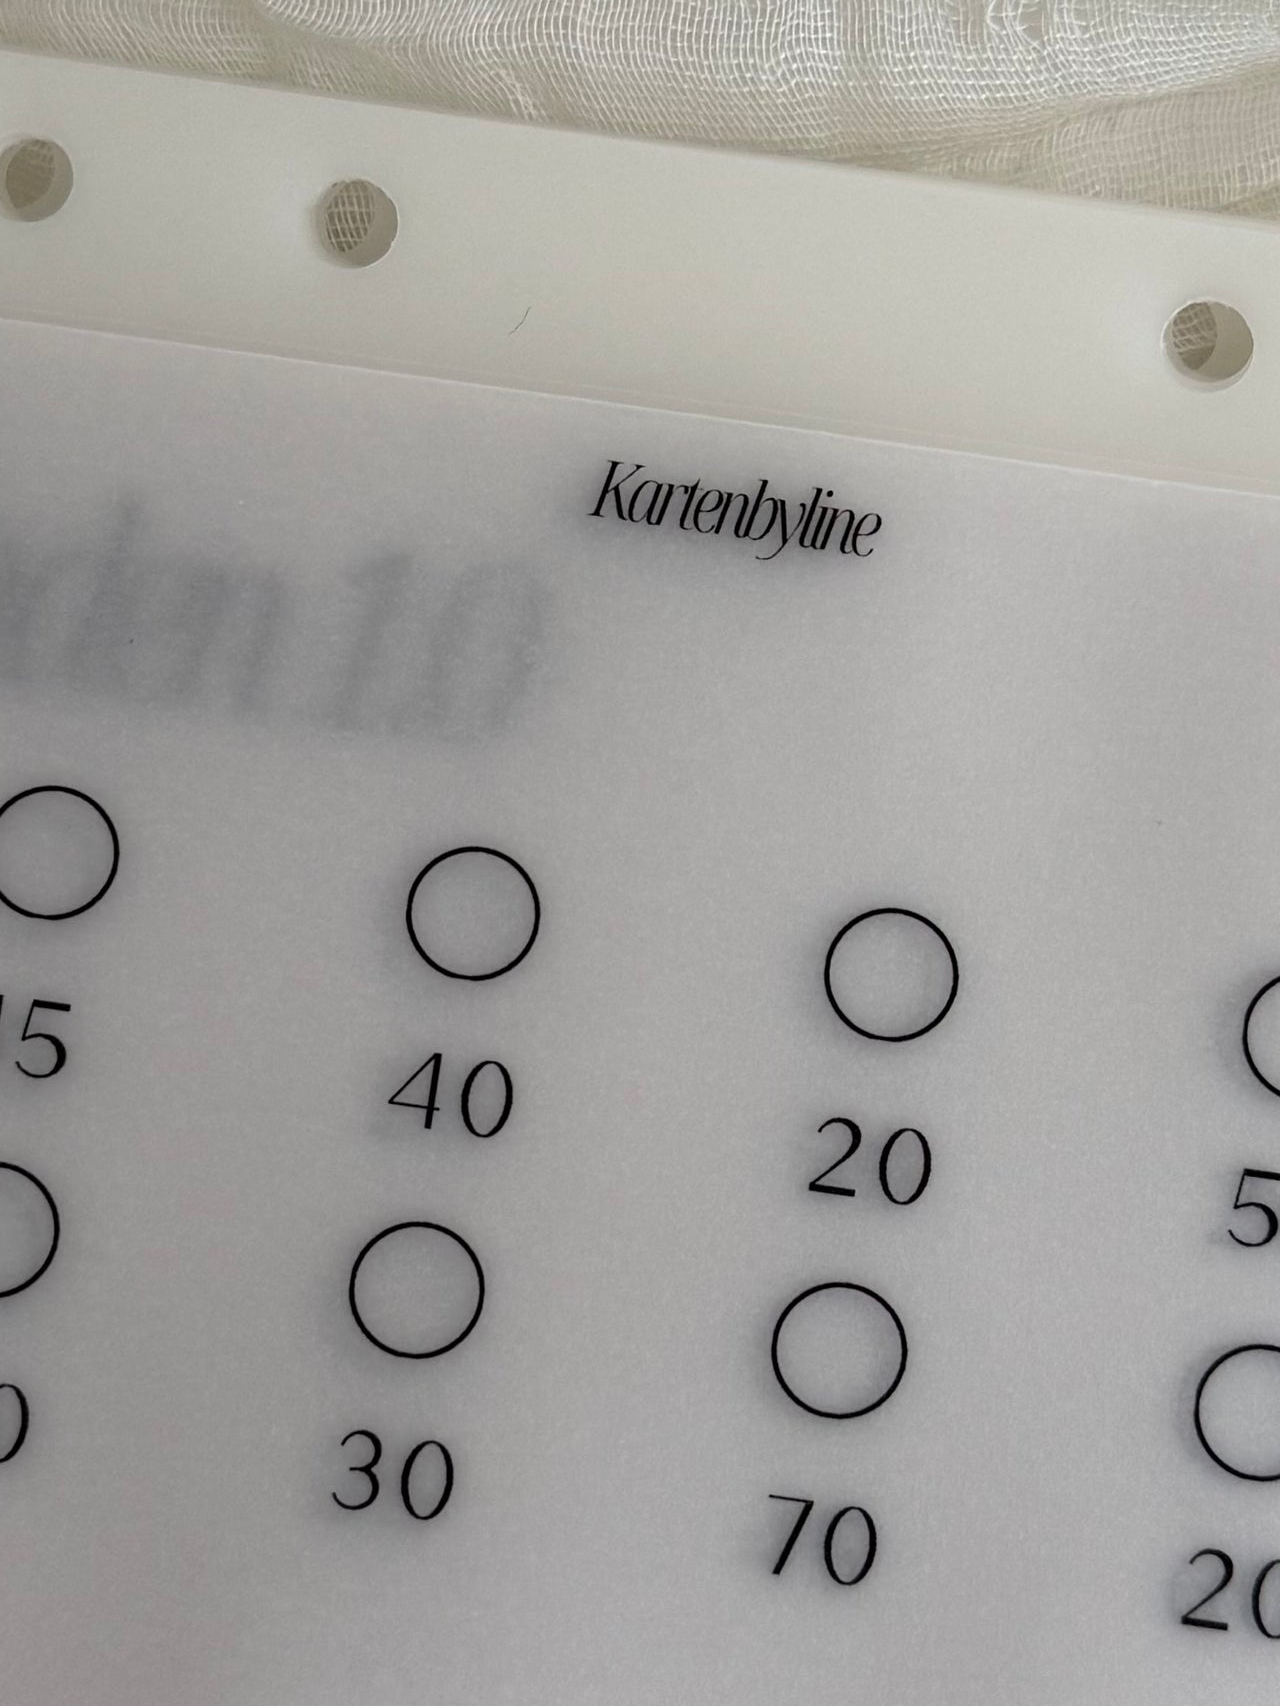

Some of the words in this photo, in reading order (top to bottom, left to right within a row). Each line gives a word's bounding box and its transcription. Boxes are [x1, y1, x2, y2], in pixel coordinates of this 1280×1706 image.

[587, 459, 883, 560] Kartenbyline
[389, 1054, 513, 1137] 40
[808, 1118, 931, 1204] 20
[332, 1430, 453, 1521] 30
[769, 1495, 877, 1585] 70
